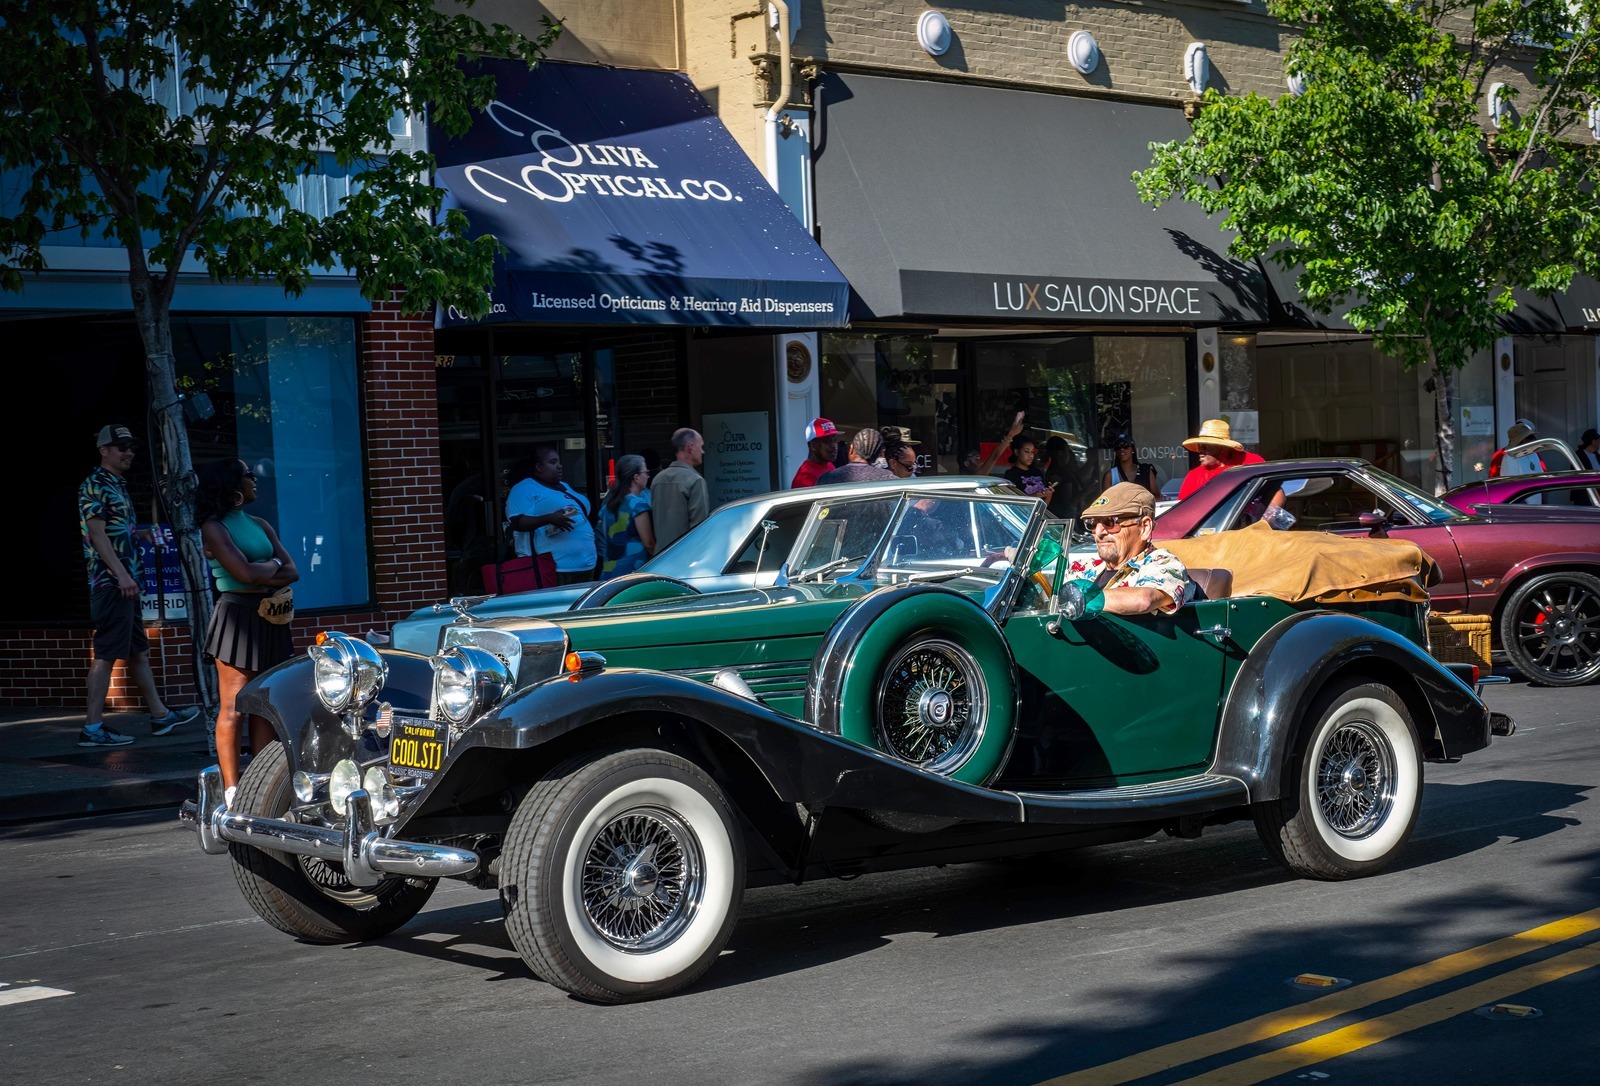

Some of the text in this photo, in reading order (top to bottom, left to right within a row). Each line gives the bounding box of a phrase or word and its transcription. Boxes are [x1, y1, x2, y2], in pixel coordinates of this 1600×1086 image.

[520, 165, 686, 203] OPTICAL
[531, 292, 835, 316] Licensed Opticians & Hearing Aid Dispensers
[993, 282, 1201, 314] LUX SALON SPACE
[144, 566, 181, 575] BRWN
[145, 578, 181, 588] TUTLE
[404, 725, 436, 738] CALIFORNIA
[392, 738, 442, 770] COOLST1
[407, 769, 434, 779] ROADSTERS
